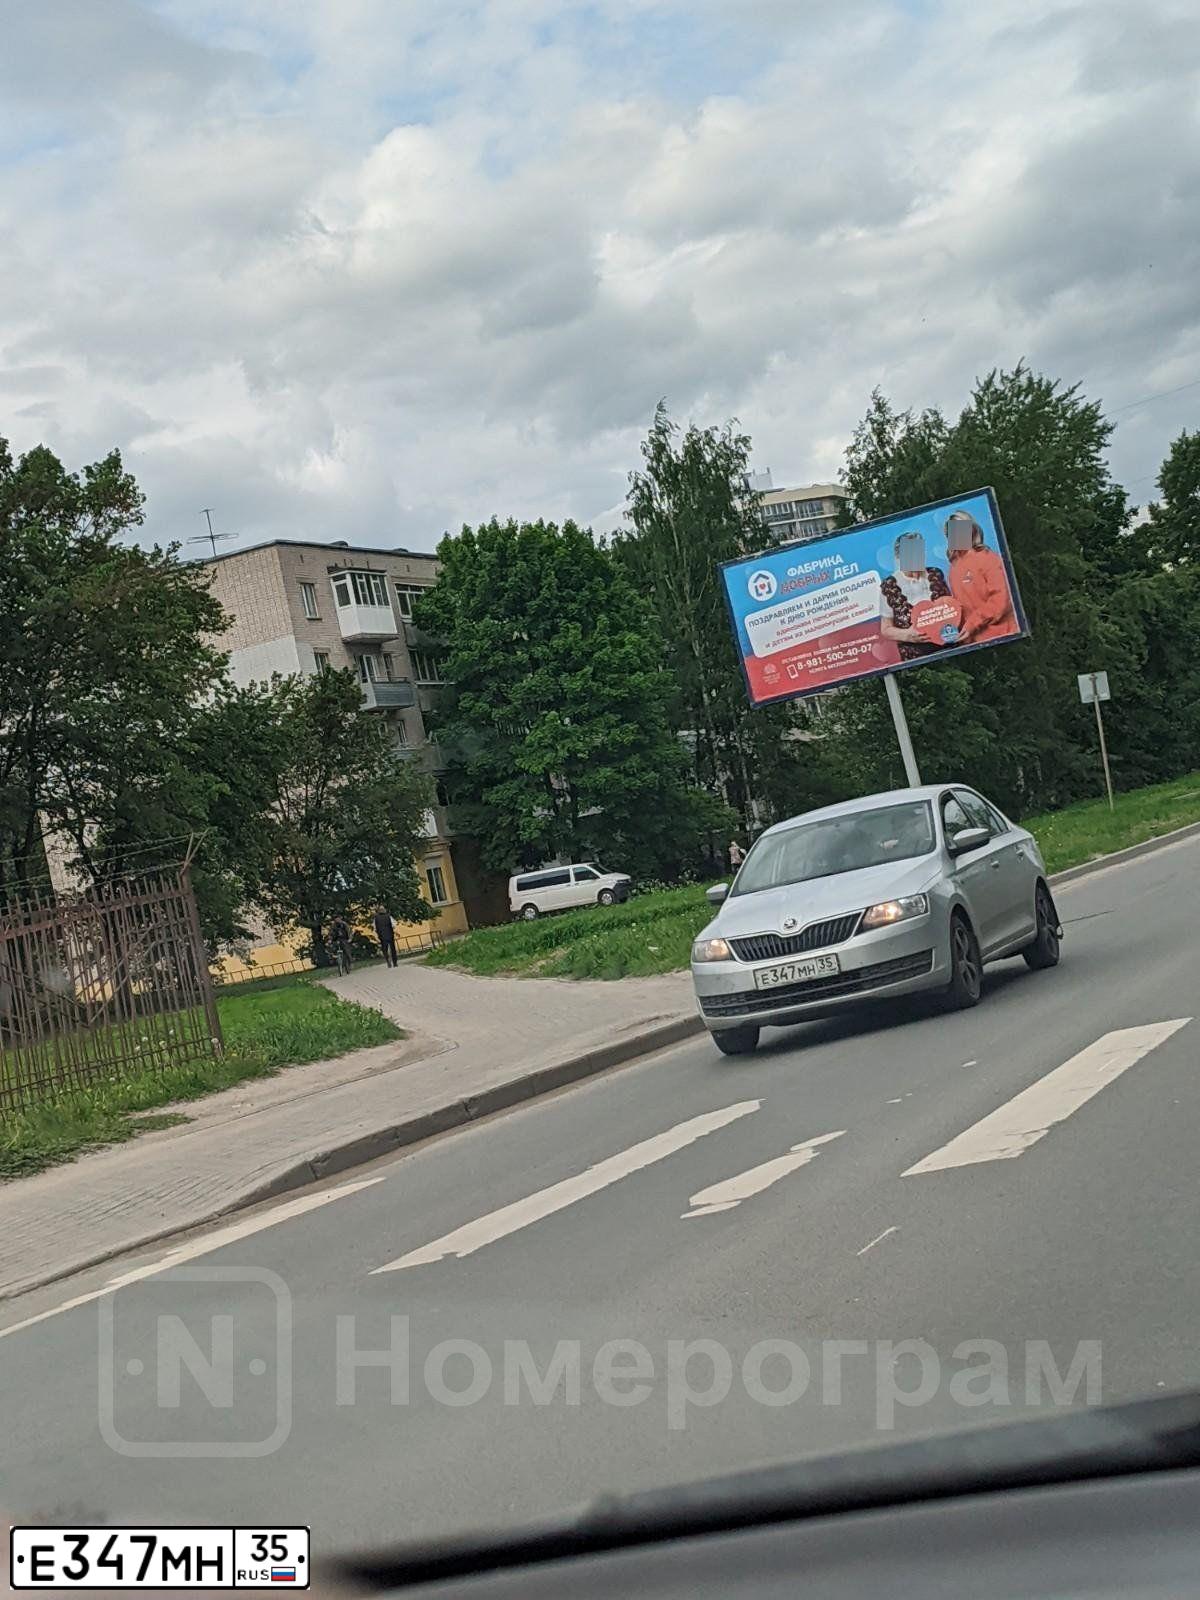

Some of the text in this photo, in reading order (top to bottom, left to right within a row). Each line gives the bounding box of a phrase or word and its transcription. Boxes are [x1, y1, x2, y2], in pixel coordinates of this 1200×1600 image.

[787, 554, 844, 577] ФАБРИКА
[833, 562, 860, 580] ДЕЛ
[748, 602, 803, 628] ПОЗДРАВЛЯЕМ
[812, 590, 839, 605] ДАРИМ
[840, 577, 877, 595] ПОДАРКИ
[780, 595, 850, 626] К ДНЮ РОЖДЕНИЯ
[796, 643, 872, 670] 8-981-500-40-07
[761, 957, 833, 985] Е347МН 35
